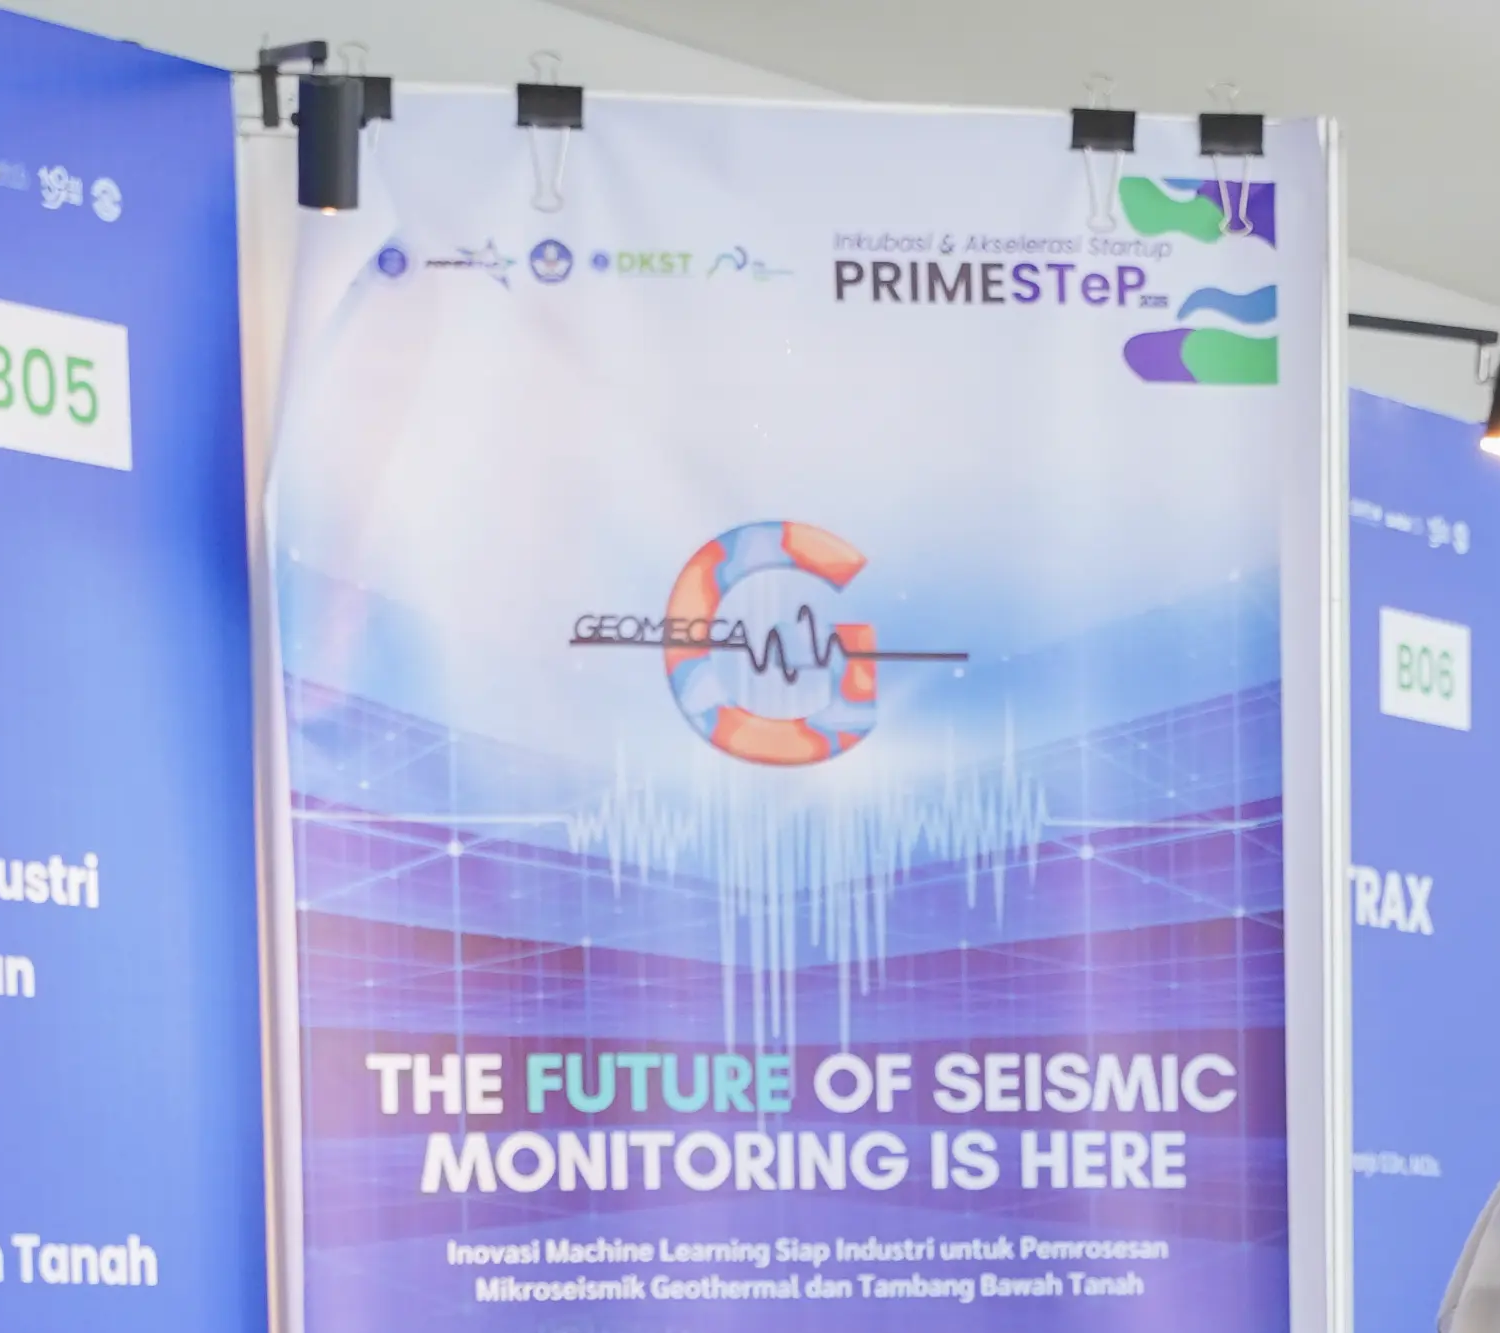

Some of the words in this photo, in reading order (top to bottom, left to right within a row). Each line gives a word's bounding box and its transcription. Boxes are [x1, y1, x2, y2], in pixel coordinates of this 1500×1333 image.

[617, 251, 694, 274] DKST
[833, 232, 932, 252] Inkubasi
[938, 234, 956, 255] &
[965, 235, 1082, 254] Akselerasi
[1087, 236, 1174, 261] Startup
[834, 260, 1147, 307] PRIMESTeP
[572, 613, 749, 643] GEOMECCA
[1398, 643, 1454, 700] B06
[367, 1052, 504, 1115] THE
[526, 1052, 792, 1115] FUTURE
[812, 1052, 913, 1115] OF
[932, 1051, 1238, 1115] SEISMIC
[419, 1130, 907, 1195] MONITORING
[931, 1130, 999, 1191] IS
[1019, 1129, 1187, 1190] HERE
[10, 1233, 158, 1288] Tanah
[447, 1239, 541, 1265] Inovasi
[545, 1237, 655, 1264] Machine
[659, 1237, 770, 1269] Learning
[775, 1237, 831, 1269] Siap
[836, 1236, 935, 1262] Industri
[940, 1235, 1015, 1261] untuk
[1019, 1235, 1170, 1260] Pemrosesan
[475, 1274, 646, 1303] Mikroseismik
[649, 1274, 802, 1301] Geothermal
[805, 1273, 853, 1299] dan
[857, 1272, 976, 1304] Tambang
[980, 1271, 1062, 1298] Bawah
[1066, 1270, 1144, 1297] Tanah
